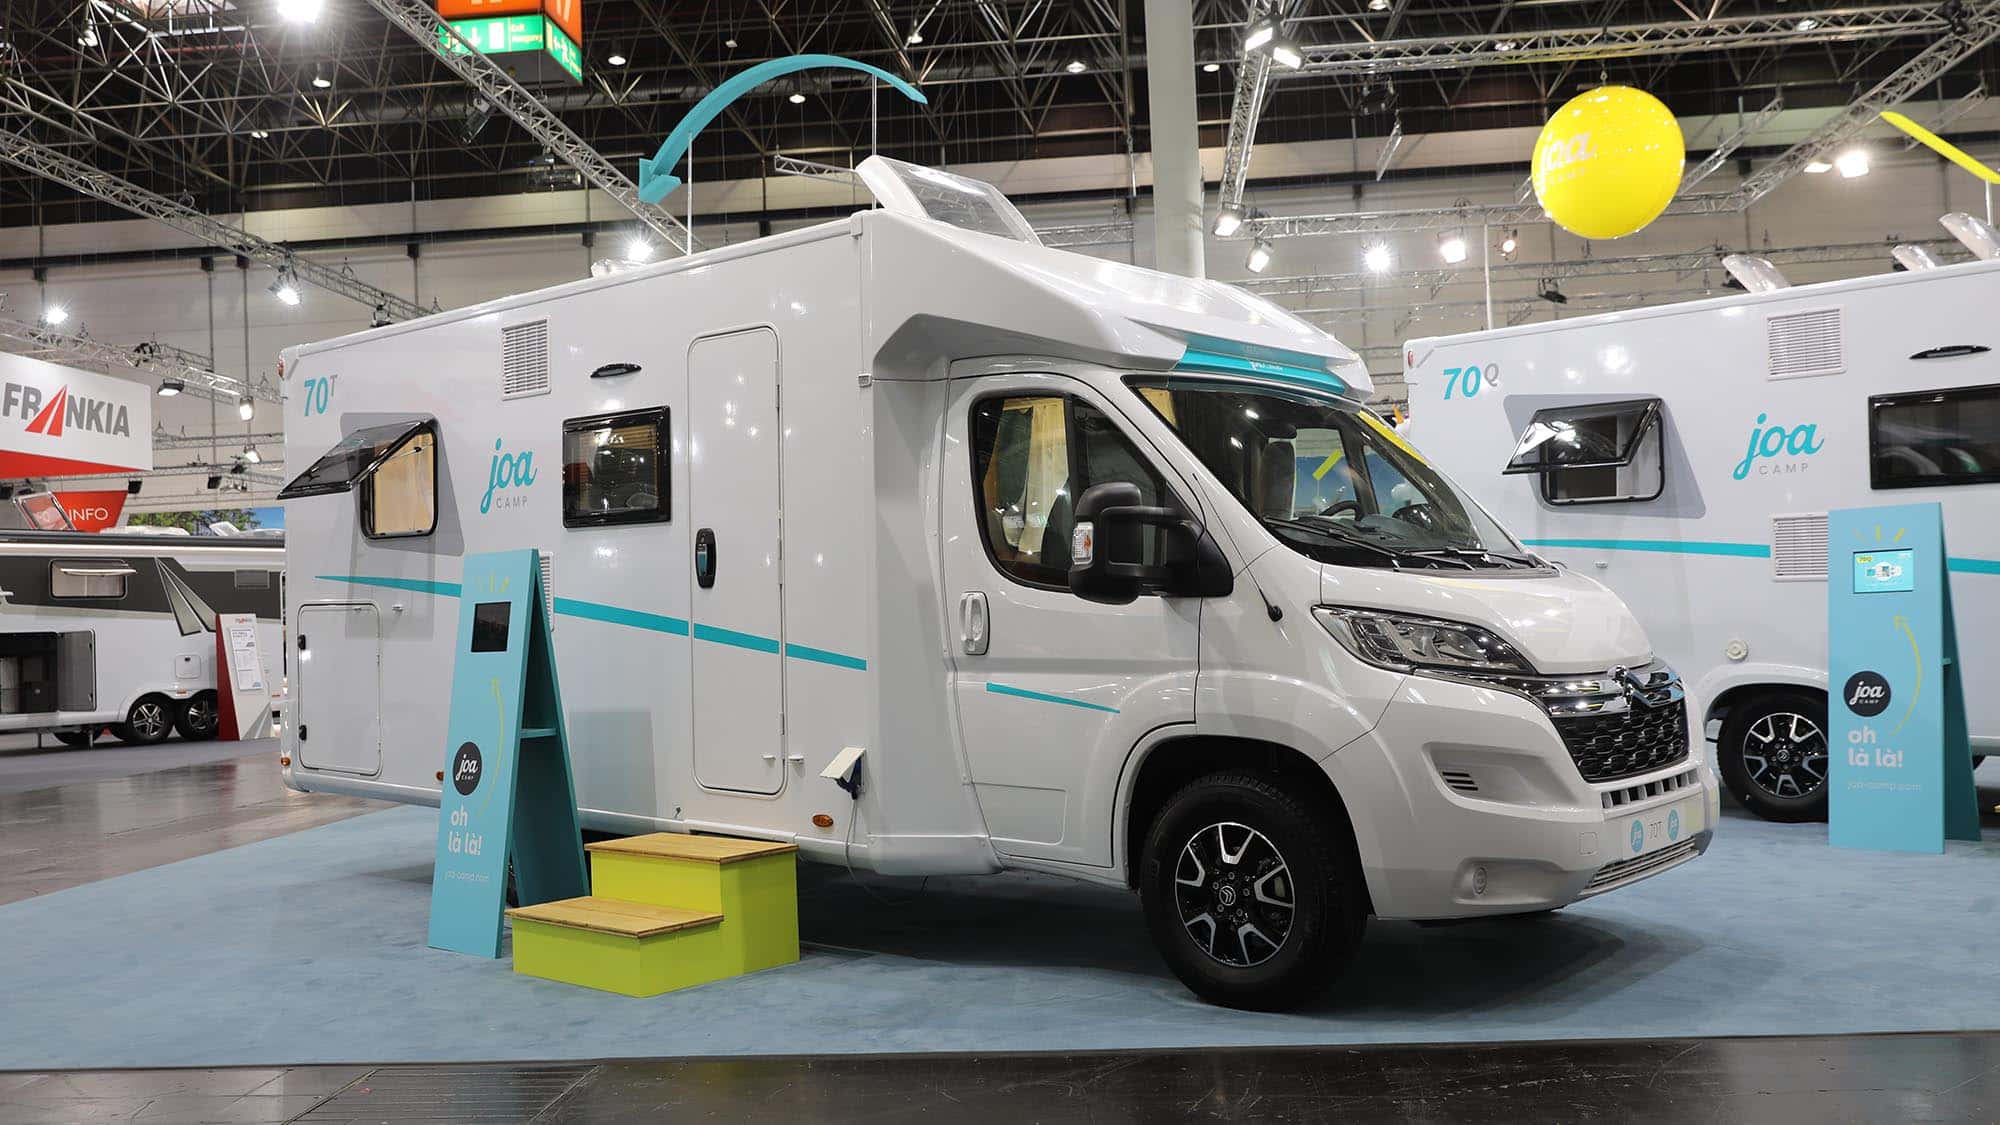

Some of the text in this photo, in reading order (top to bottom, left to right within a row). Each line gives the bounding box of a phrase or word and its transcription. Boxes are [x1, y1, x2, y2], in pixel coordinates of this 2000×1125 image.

[2, 382, 130, 437] FRANKIA
[1733, 413, 1825, 481] joa
[480, 437, 538, 514] joa
[1759, 463, 1809, 475] CAMP
[495, 495, 529, 509] CAMP
[69, 507, 109, 521] INFO
[1849, 681, 1885, 705] joa
[1848, 725, 1877, 744] oh
[456, 754, 479, 781] joa
[1848, 747, 1904, 768] là là!
[451, 804, 468, 826] oh
[448, 831, 483, 856] là là!
